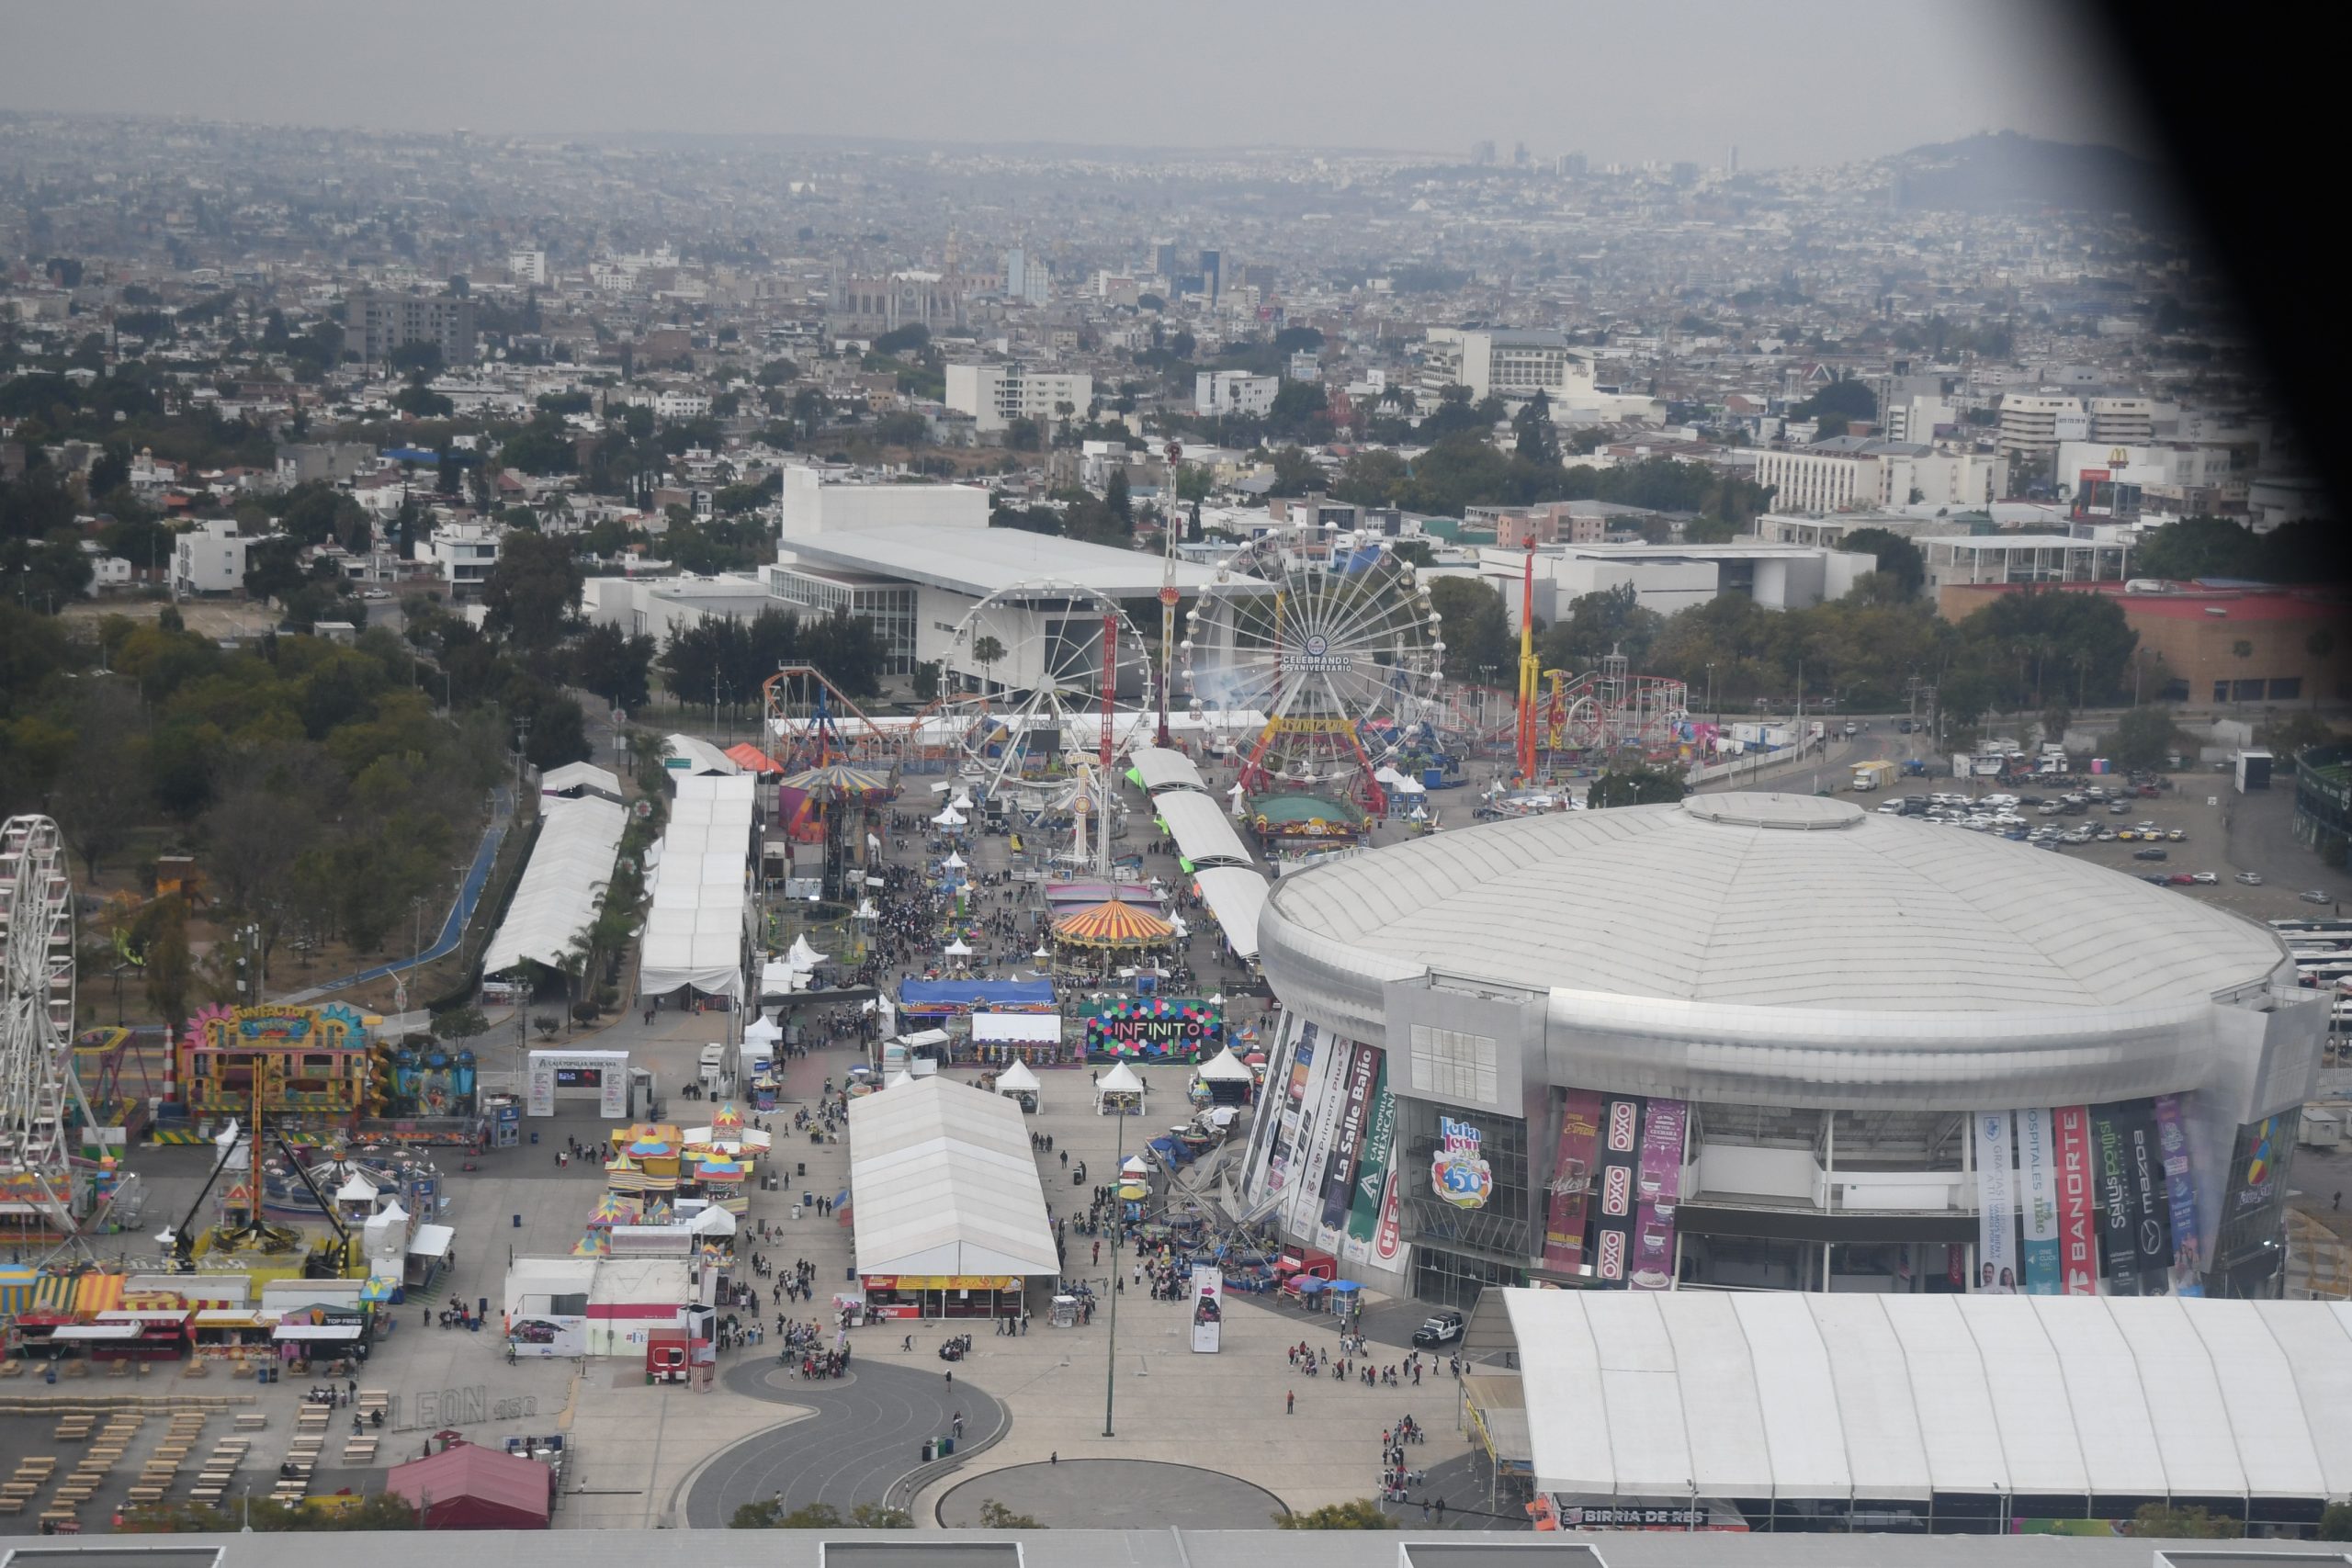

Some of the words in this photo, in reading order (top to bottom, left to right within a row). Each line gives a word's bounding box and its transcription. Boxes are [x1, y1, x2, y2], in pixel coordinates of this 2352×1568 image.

[1283, 656, 1350, 665] CELEBRANDO
[1294, 664, 1351, 672] ANIVERSARIO
[1114, 1022, 1200, 1040] INFINITO
[1351, 1050, 1372, 1101] Bajío
[1318, 1096, 1336, 1150] Primera
[1332, 1061, 1343, 1091] Plus
[1614, 1104, 1631, 1148] OXXO
[1341, 1105, 1361, 1155] Salle
[1370, 1133, 1380, 1161] CAJA
[2028, 1108, 2041, 1190] OSPITALES
[1334, 1159, 1349, 1182] La
[1442, 1166, 1482, 1193] 450
[1609, 1168, 1624, 1213] OXXO
[2064, 1111, 2086, 1261] BANORTE
[2133, 1130, 2154, 1214] mazda
[1603, 1233, 1620, 1278] OXXO
[391, 1385, 486, 1434] LEON
[1585, 1510, 1641, 1523] BIRRIA
[1645, 1511, 1668, 1523] DE
[1672, 1511, 1703, 1523] RES
